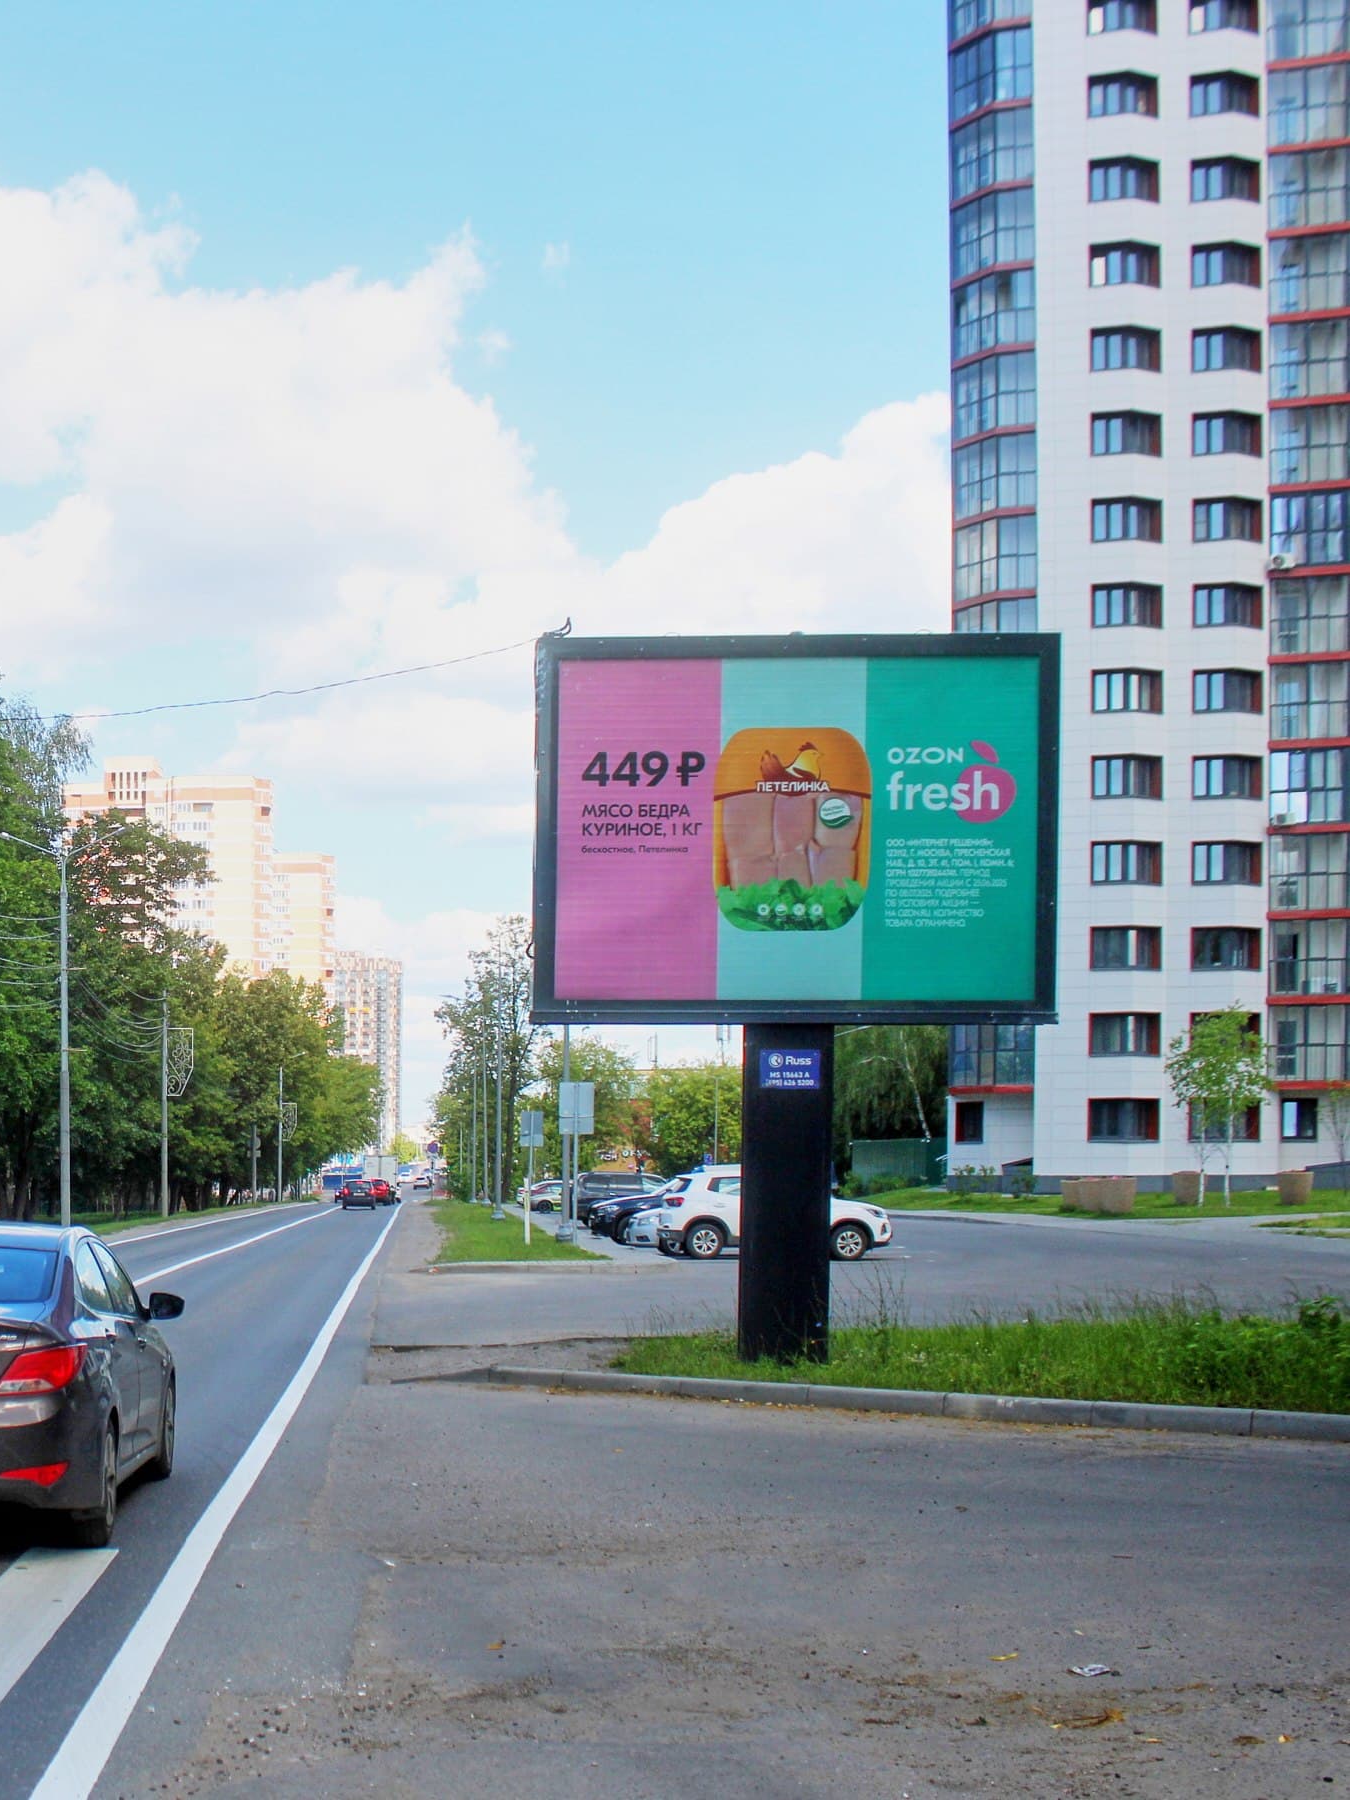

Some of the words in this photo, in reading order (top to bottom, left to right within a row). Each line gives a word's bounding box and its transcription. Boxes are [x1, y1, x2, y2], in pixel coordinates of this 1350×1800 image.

[887, 746, 964, 765] OZON
[581, 750, 669, 787] 449
[756, 781, 830, 792] ПЕТЕЛИНКА
[886, 770, 1000, 811] fresh
[581, 804, 633, 818] МЯСО
[638, 804, 690, 819] БЕДРА
[581, 822, 667, 837] КУРИНОЕ,
[682, 822, 703, 836] КГ
[638, 844, 688, 853] Петелинка
[885, 838, 905, 847] ООО
[785, 1055, 812, 1065] Russ
